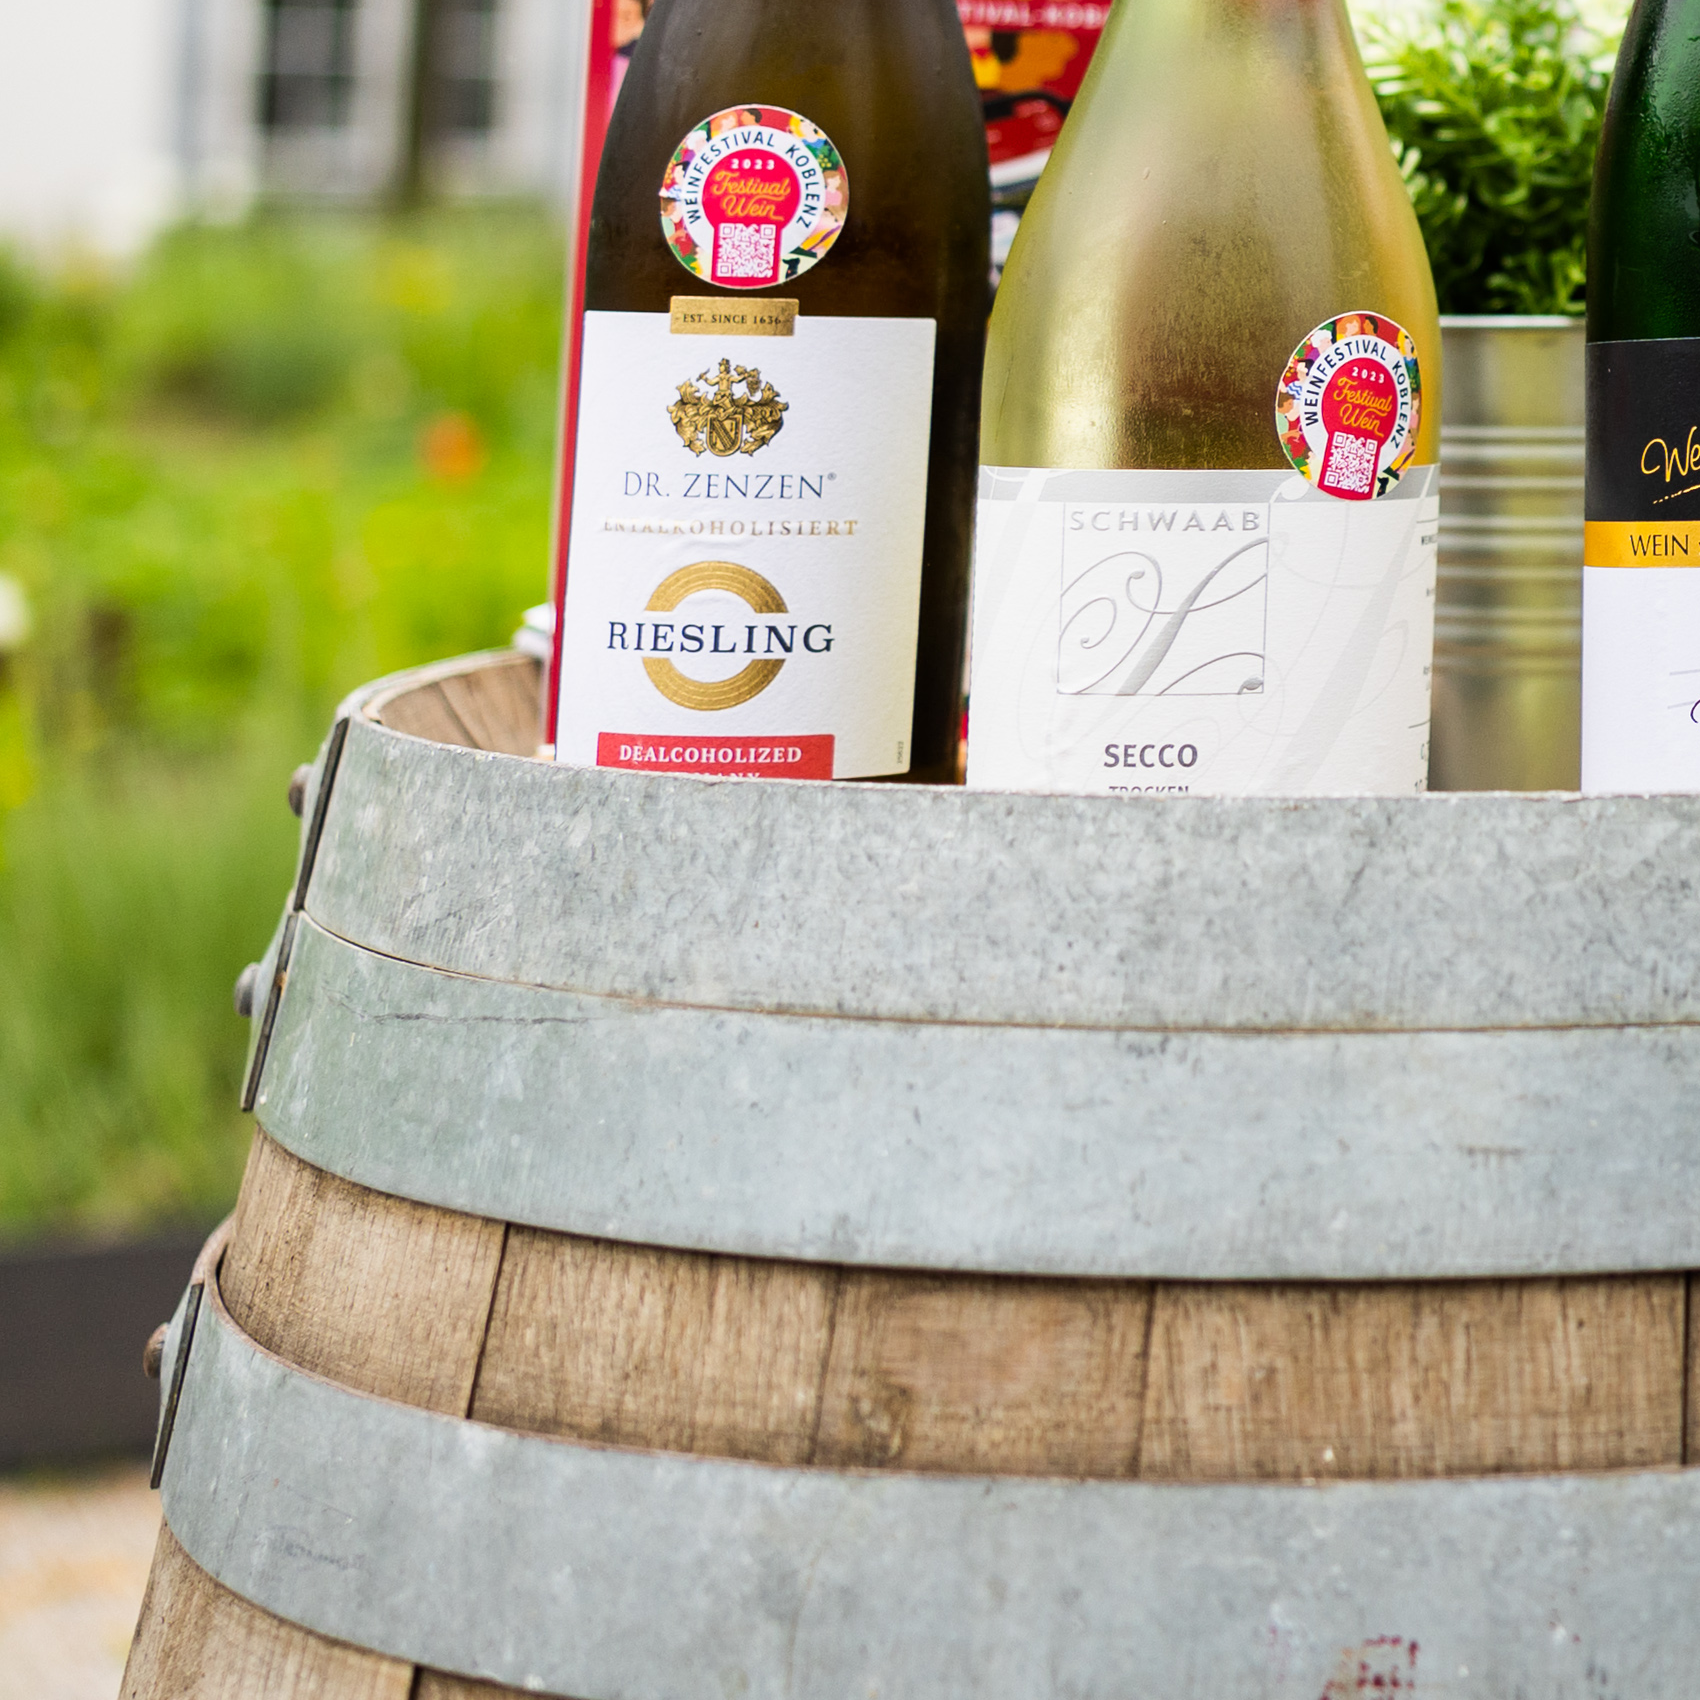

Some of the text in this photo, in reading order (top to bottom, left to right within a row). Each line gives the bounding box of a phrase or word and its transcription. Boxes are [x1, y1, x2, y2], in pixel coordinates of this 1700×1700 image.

[730, 158, 776, 170] 2023
[684, 130, 821, 229] WEINFESTIVAL KOBLENZ
[712, 169, 792, 197] Festival
[722, 193, 785, 221] Wein
[682, 313, 707, 325] EST.
[711, 314, 748, 325] SINCE
[1351, 366, 1386, 384] 2023
[1303, 338, 1410, 450] WEINFESTIVAL KOBLENZ
[1332, 376, 1393, 412] Festival
[1339, 402, 1389, 438] Wein
[623, 470, 670, 498] DR.
[1069, 509, 1261, 532] SCHWAAB
[1630, 533, 1690, 557] WEIN
[607, 620, 836, 654] RIESLING
[618, 744, 803, 764] DEALCOHOLIZED
[1103, 743, 1199, 769] SECCO
